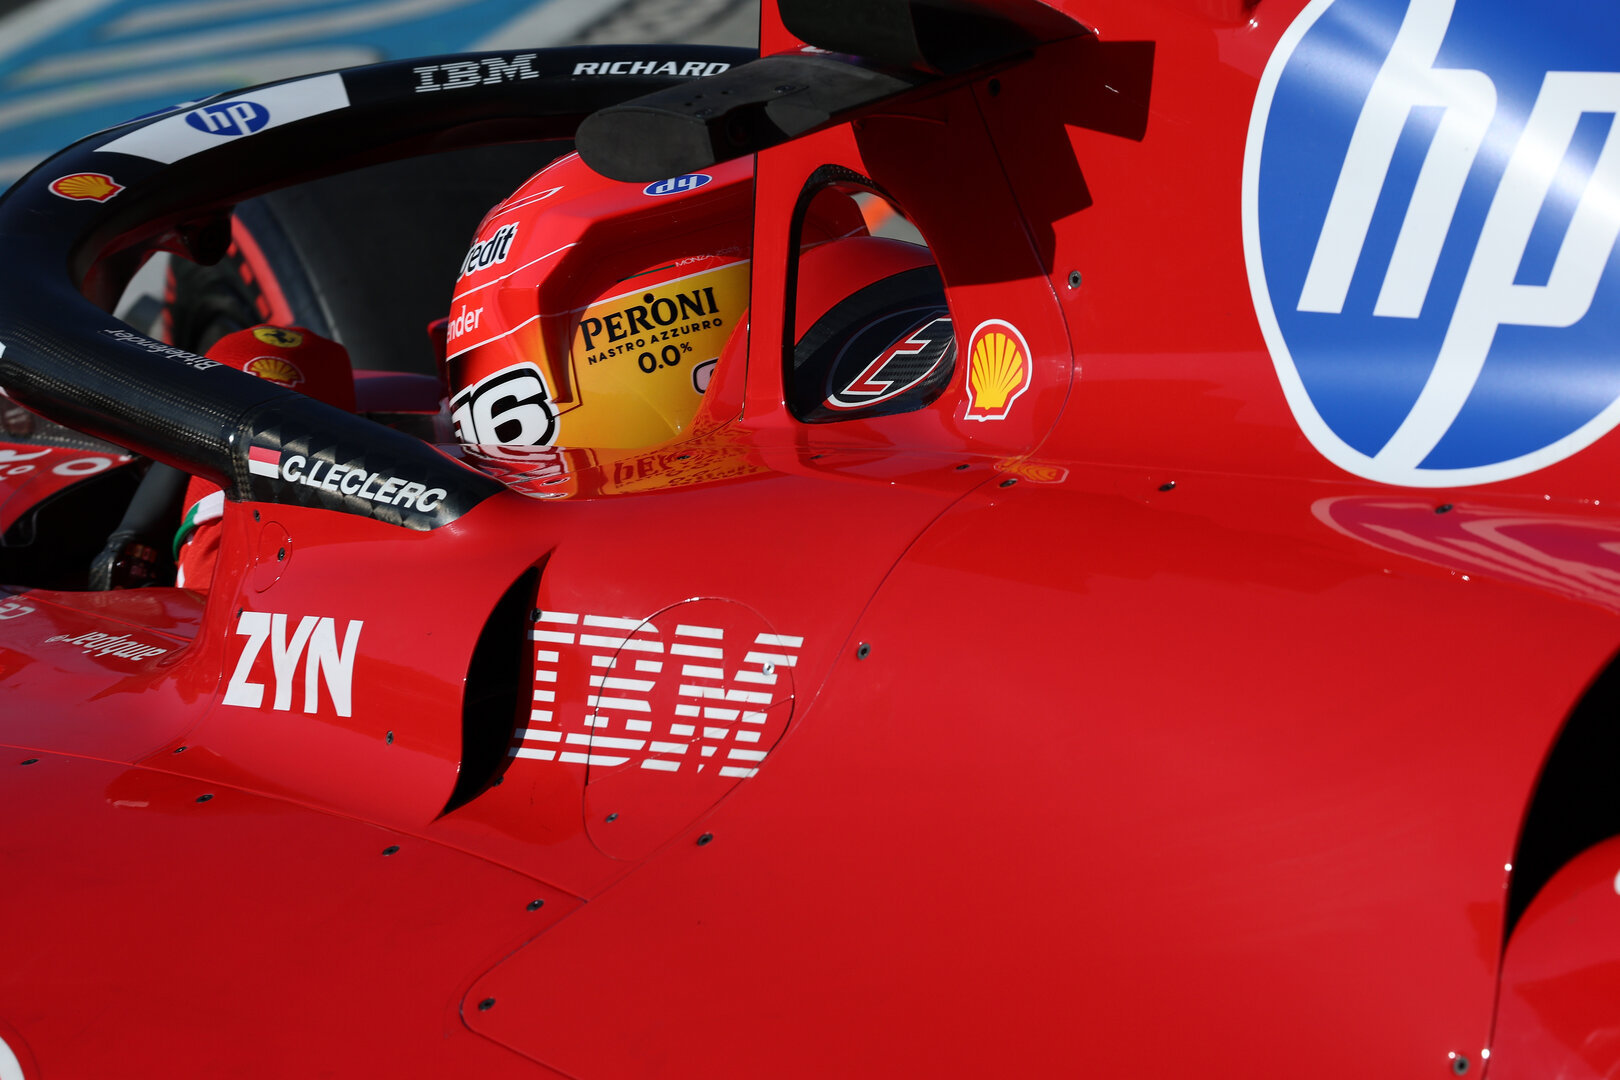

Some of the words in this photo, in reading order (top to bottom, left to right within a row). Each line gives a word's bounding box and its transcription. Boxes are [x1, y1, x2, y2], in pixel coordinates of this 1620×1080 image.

[413, 53, 540, 93] IBM
[572, 61, 731, 77] RICHARD
[199, 102, 257, 136] hp
[579, 286, 720, 352] PERONI
[587, 338, 646, 366] NASTRO
[650, 317, 723, 345] AZZURRO
[103, 328, 224, 371] Bitdefender
[637, 341, 693, 374] 0.0%
[282, 455, 448, 513] C.LECLERC
[221, 610, 364, 718] ZYN
[508, 610, 805, 778] IBM
